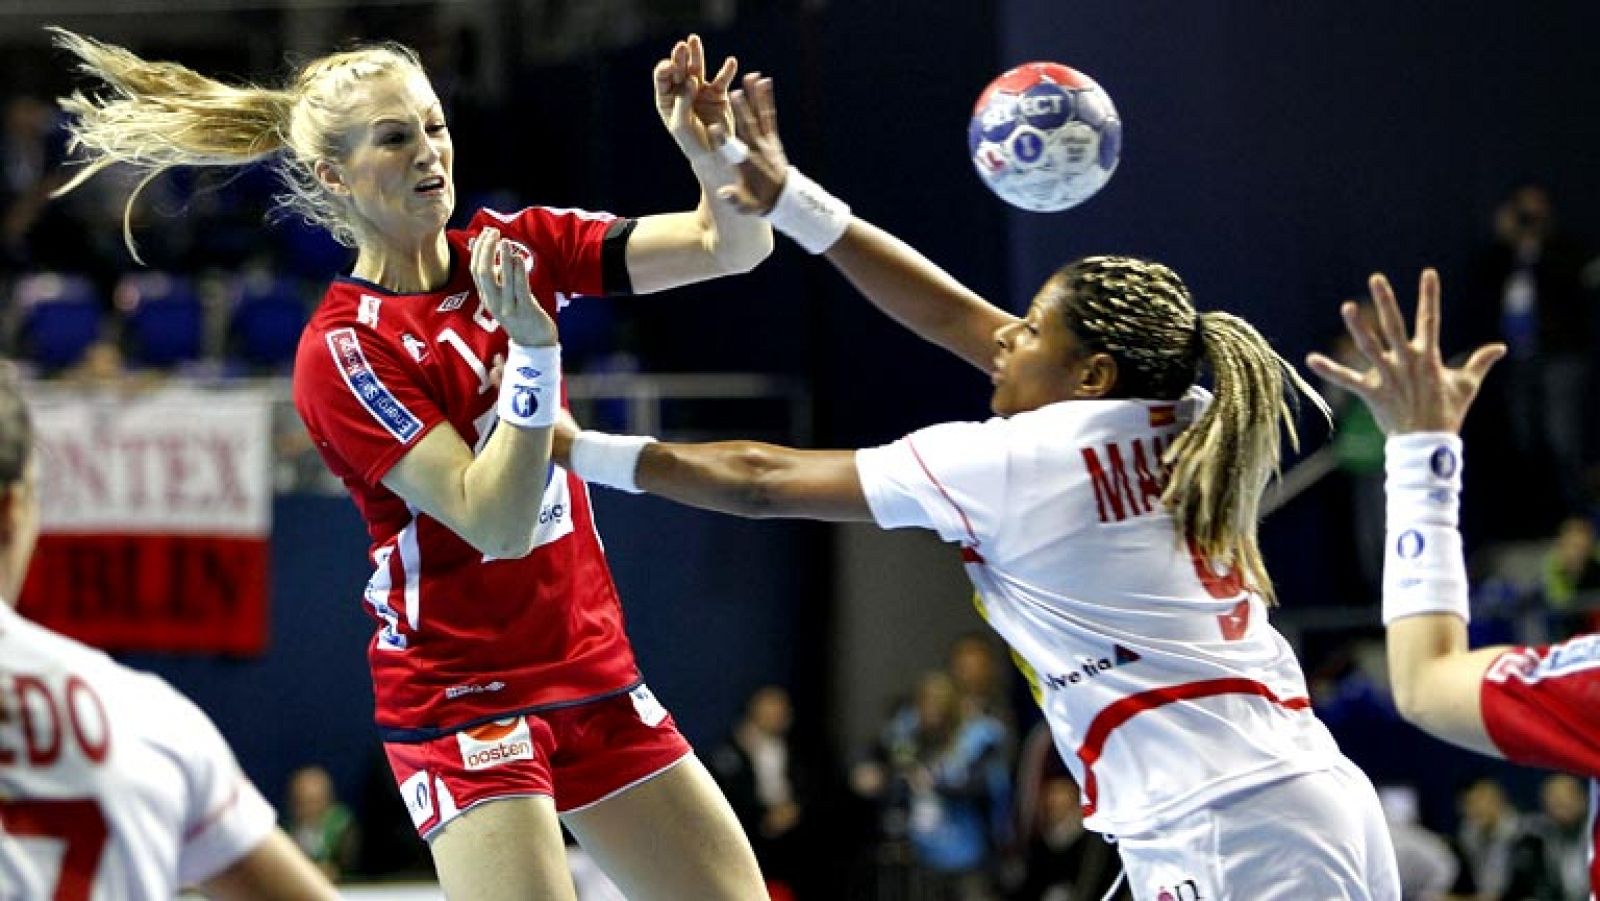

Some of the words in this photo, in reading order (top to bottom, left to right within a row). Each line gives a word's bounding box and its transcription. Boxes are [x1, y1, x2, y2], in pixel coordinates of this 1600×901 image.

[40, 544, 249, 622] BLIN
[1044, 657, 1113, 691] lvetia
[0, 795, 113, 901] 7
